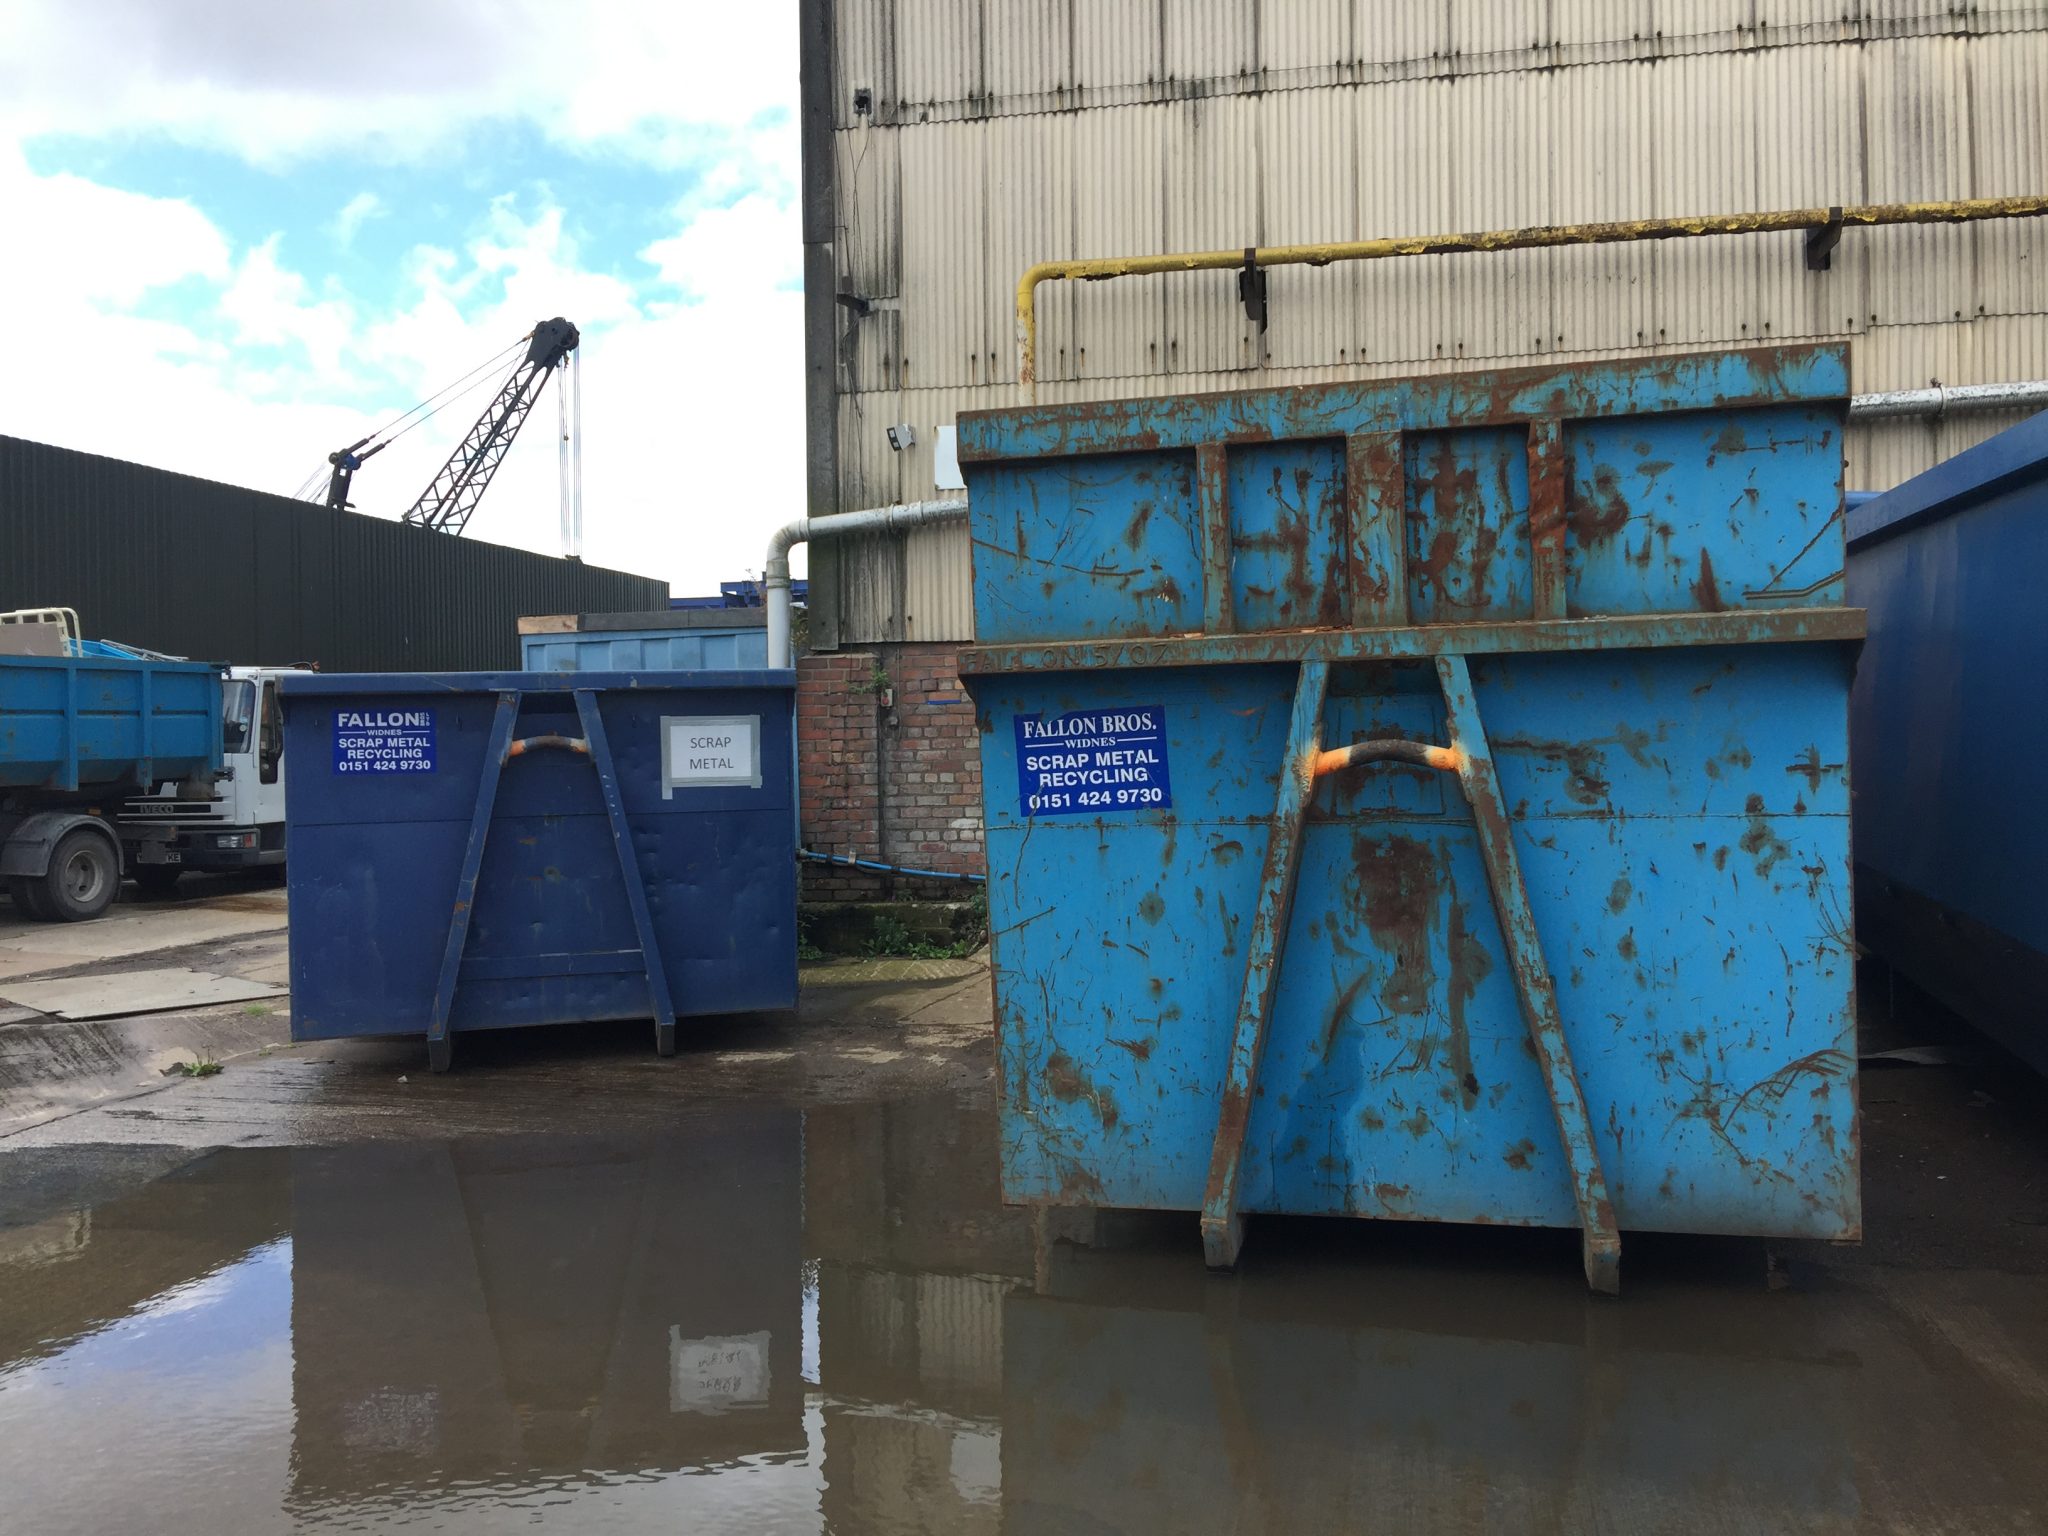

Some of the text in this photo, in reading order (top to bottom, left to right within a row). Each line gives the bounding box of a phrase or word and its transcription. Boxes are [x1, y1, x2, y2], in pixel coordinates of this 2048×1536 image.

[964, 647, 1081, 673] FALLON
[338, 712, 419, 727] FALLON
[1024, 713, 1157, 738] FALLON BROS.
[339, 737, 430, 748] SCRAP METAL
[690, 737, 732, 749] SCRAP
[1064, 737, 1116, 749] WIDNES
[347, 748, 422, 759] RECYCLING
[339, 760, 431, 771] 0151 424 9730
[689, 758, 734, 770] METAL
[1026, 749, 1159, 771] SCRAP METAL
[1039, 767, 1148, 787] RECYCLING
[1029, 788, 1162, 809] 0151 424 9730
[140, 804, 174, 814] IVECO
